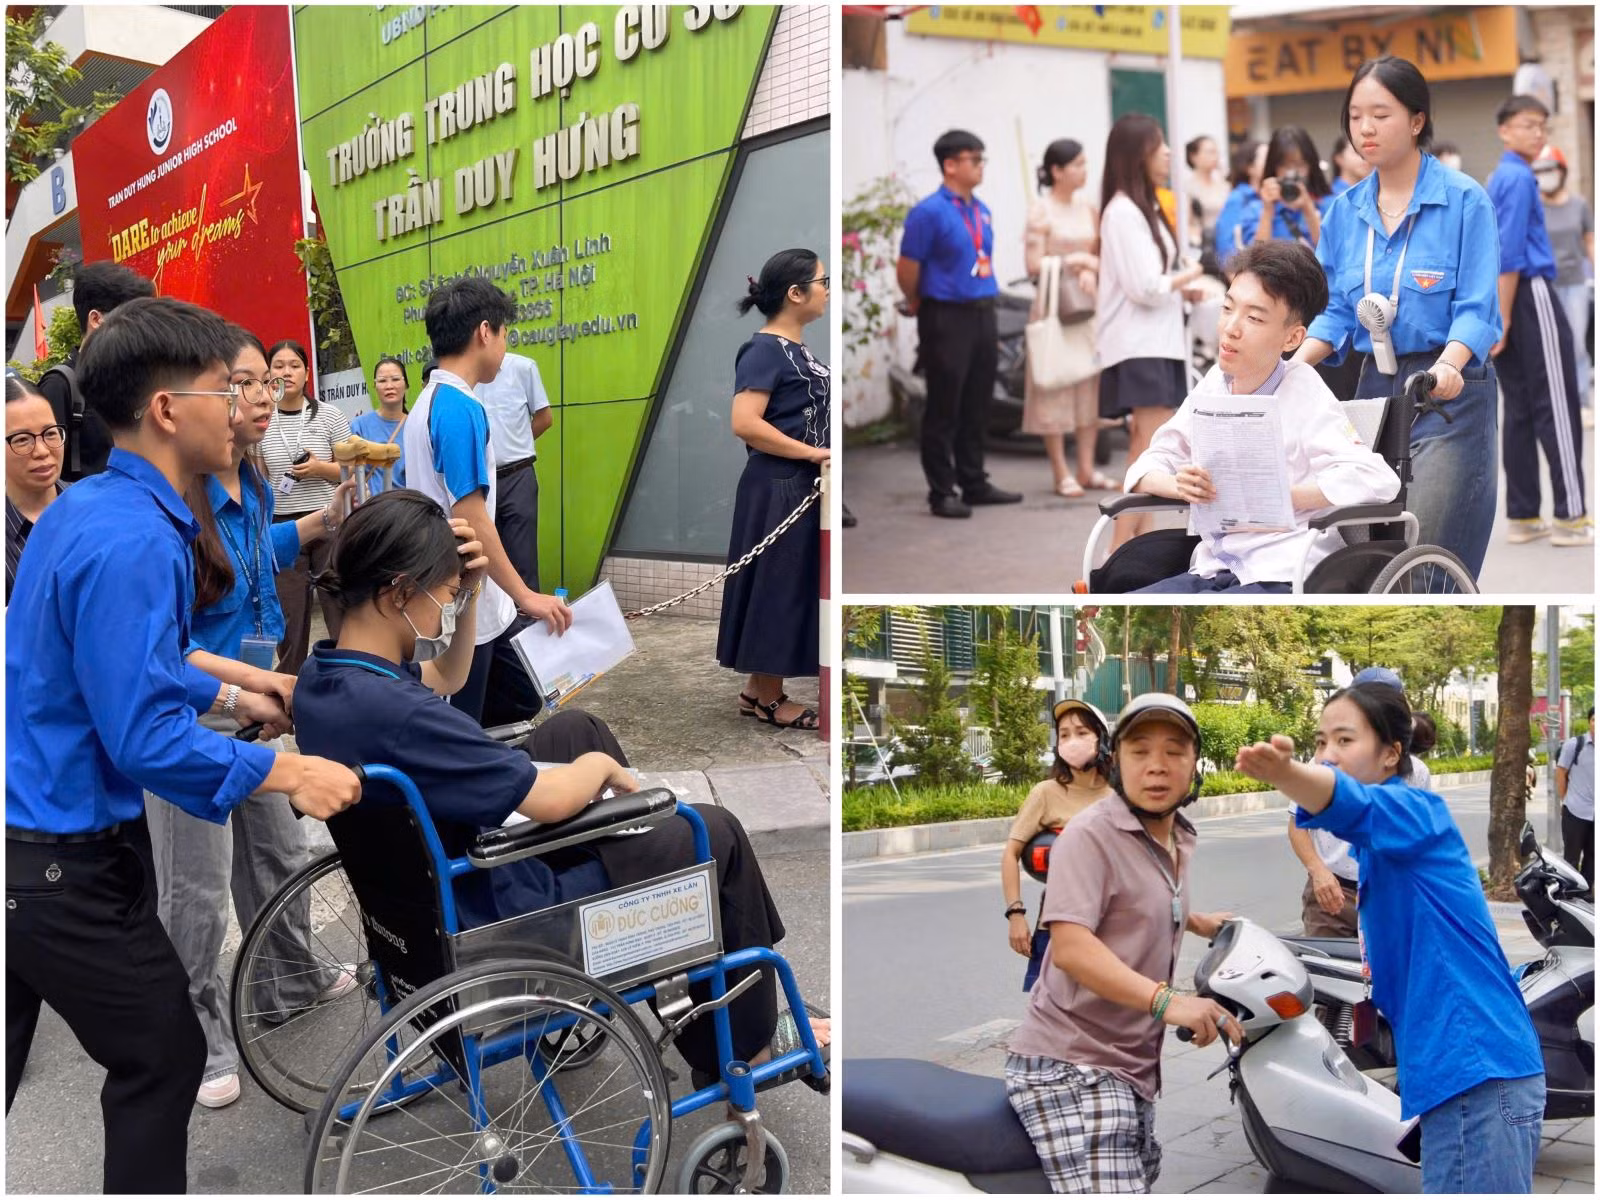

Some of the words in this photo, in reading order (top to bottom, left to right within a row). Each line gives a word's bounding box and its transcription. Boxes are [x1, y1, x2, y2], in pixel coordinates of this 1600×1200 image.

[1247, 38, 1323, 82] EAT
[327, 112, 416, 187] TRƯỜNG
[425, 62, 517, 146] TRUNG
[530, 22, 601, 99] HỌC
[108, 191, 124, 208] TRAN
[124, 181, 137, 199] DUY
[136, 170, 157, 192] HUNG
[157, 152, 183, 179] JUNIOR
[183, 139, 203, 162] HIGH
[203, 117, 238, 149] SCHOOL
[373, 167, 443, 241] TRẦN
[455, 148, 520, 215] DUY
[534, 102, 640, 190] HƯNG
[51, 167, 67, 215] B
[112, 218, 150, 263] DARE
[151, 225, 161, 245] to
[161, 208, 199, 240] achieve
[152, 238, 187, 283] your
[192, 183, 244, 262] dreams
[575, 232, 611, 259] Linh
[346, 384, 361, 398] DUY
[618, 899, 640, 910] CÔNG
[673, 886, 682, 894] XE
[618, 908, 647, 932] ĐỨC
